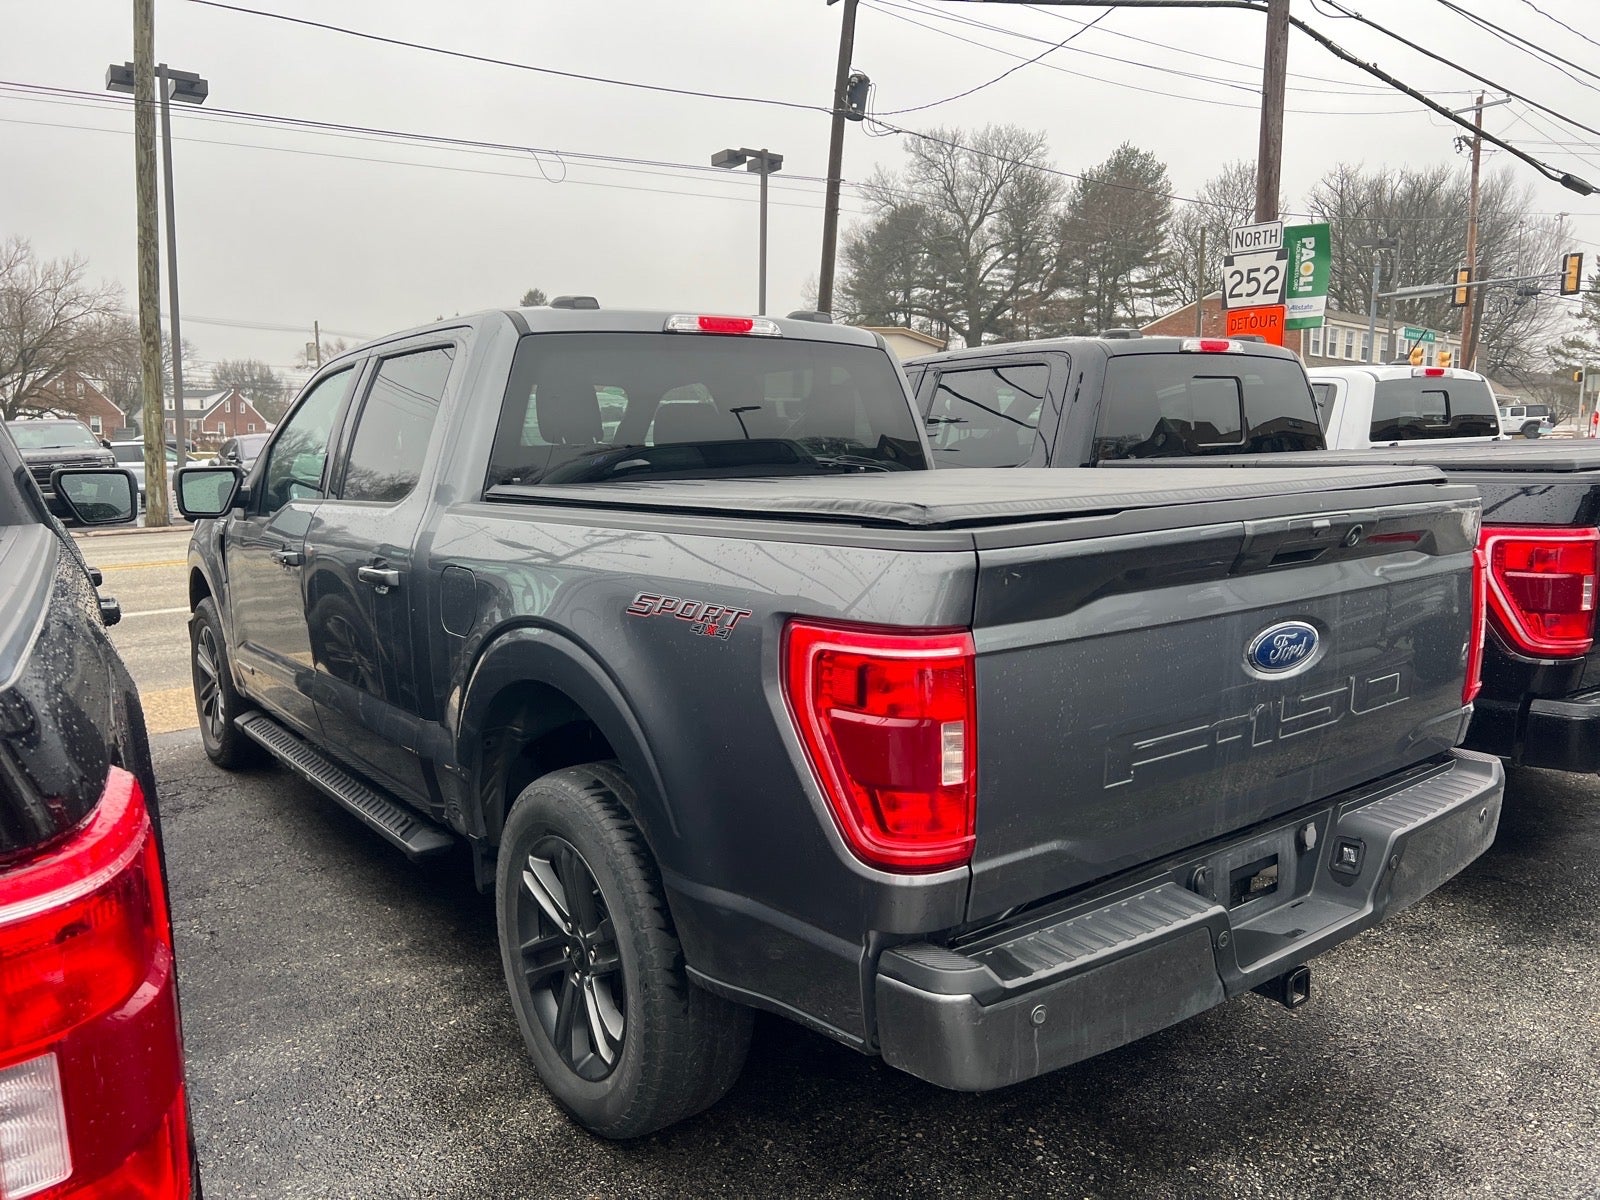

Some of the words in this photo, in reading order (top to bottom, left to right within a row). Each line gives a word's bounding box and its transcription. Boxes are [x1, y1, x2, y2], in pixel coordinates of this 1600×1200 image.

[1234, 228, 1278, 249] NORTH
[1298, 236, 1315, 292] PAOLI
[1228, 265, 1280, 299] 252
[1230, 314, 1278, 331] DETOUR
[626, 591, 752, 630] SPORT
[1269, 632, 1307, 663] Ford
[1103, 666, 1412, 789] F-150
